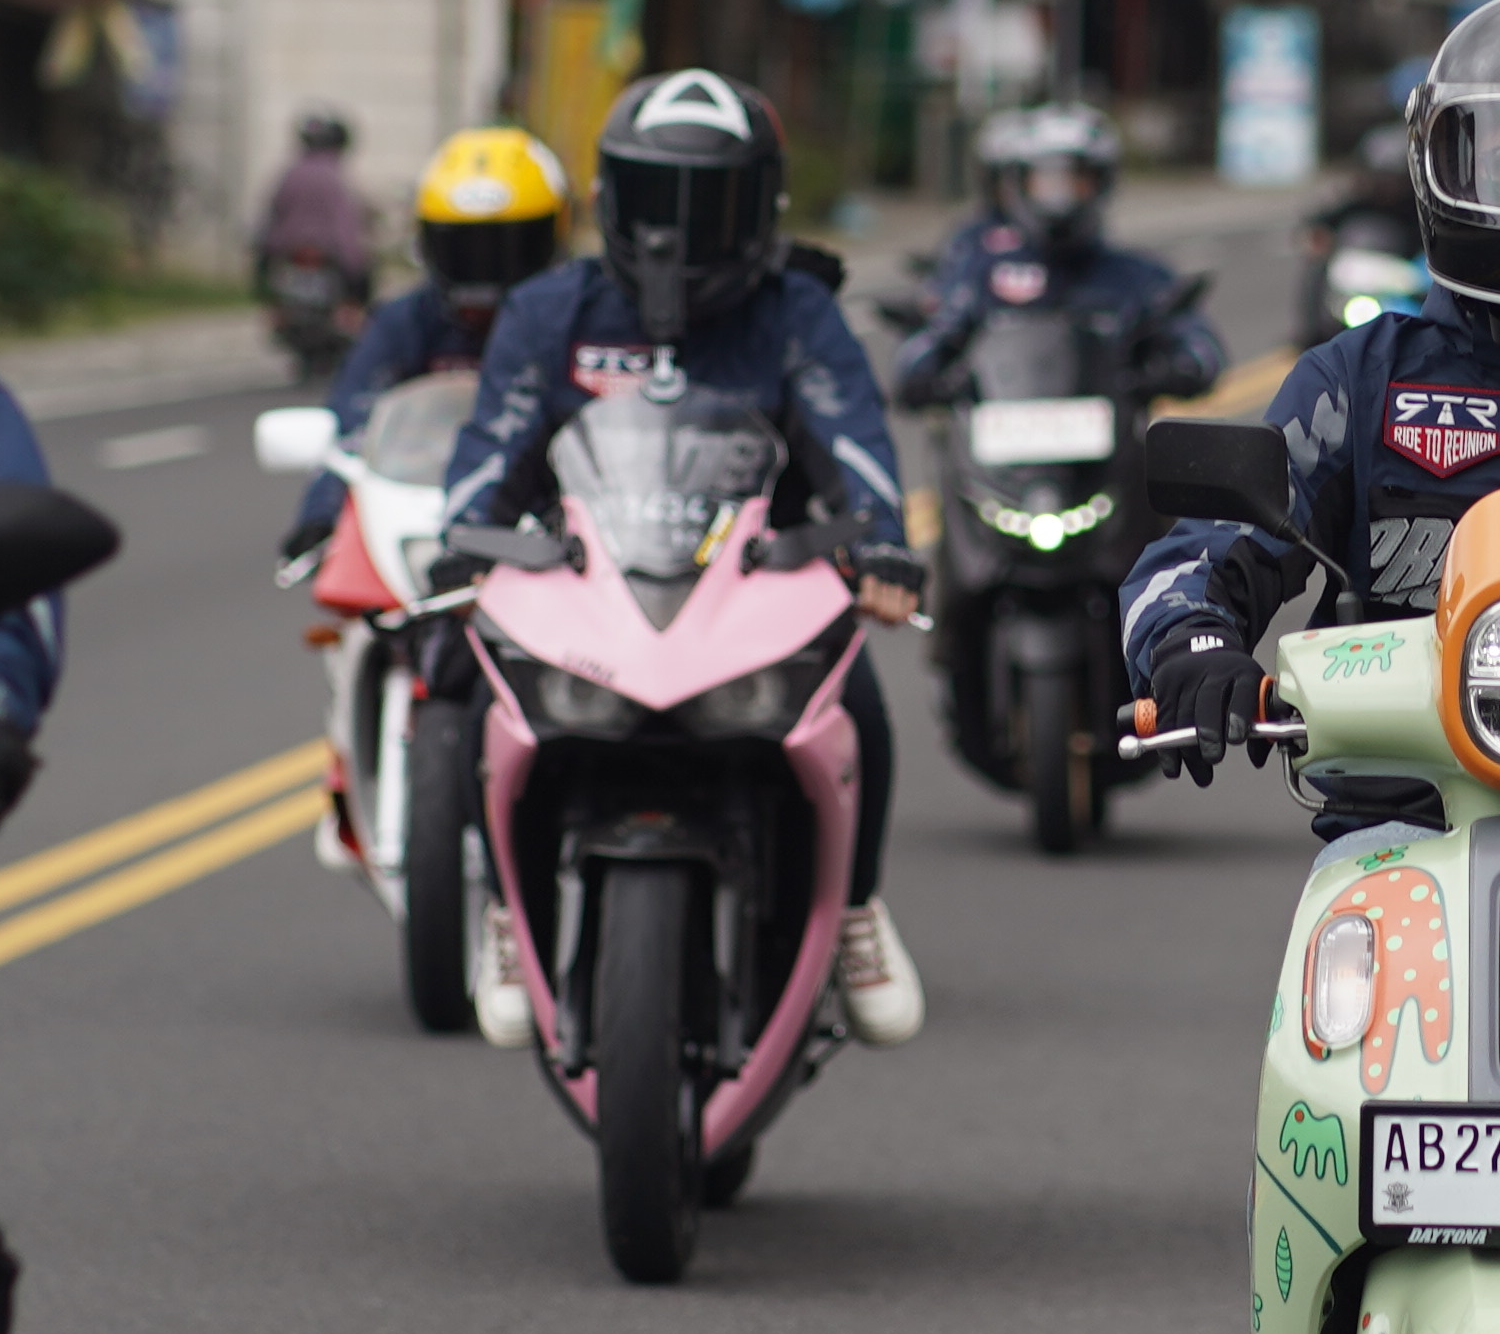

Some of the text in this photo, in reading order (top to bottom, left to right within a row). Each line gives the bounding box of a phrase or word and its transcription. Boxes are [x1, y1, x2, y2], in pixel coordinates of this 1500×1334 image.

[1394, 426, 1496, 469] RIDE TO REUNION
[1407, 1226, 1488, 1246] DAYTONA
